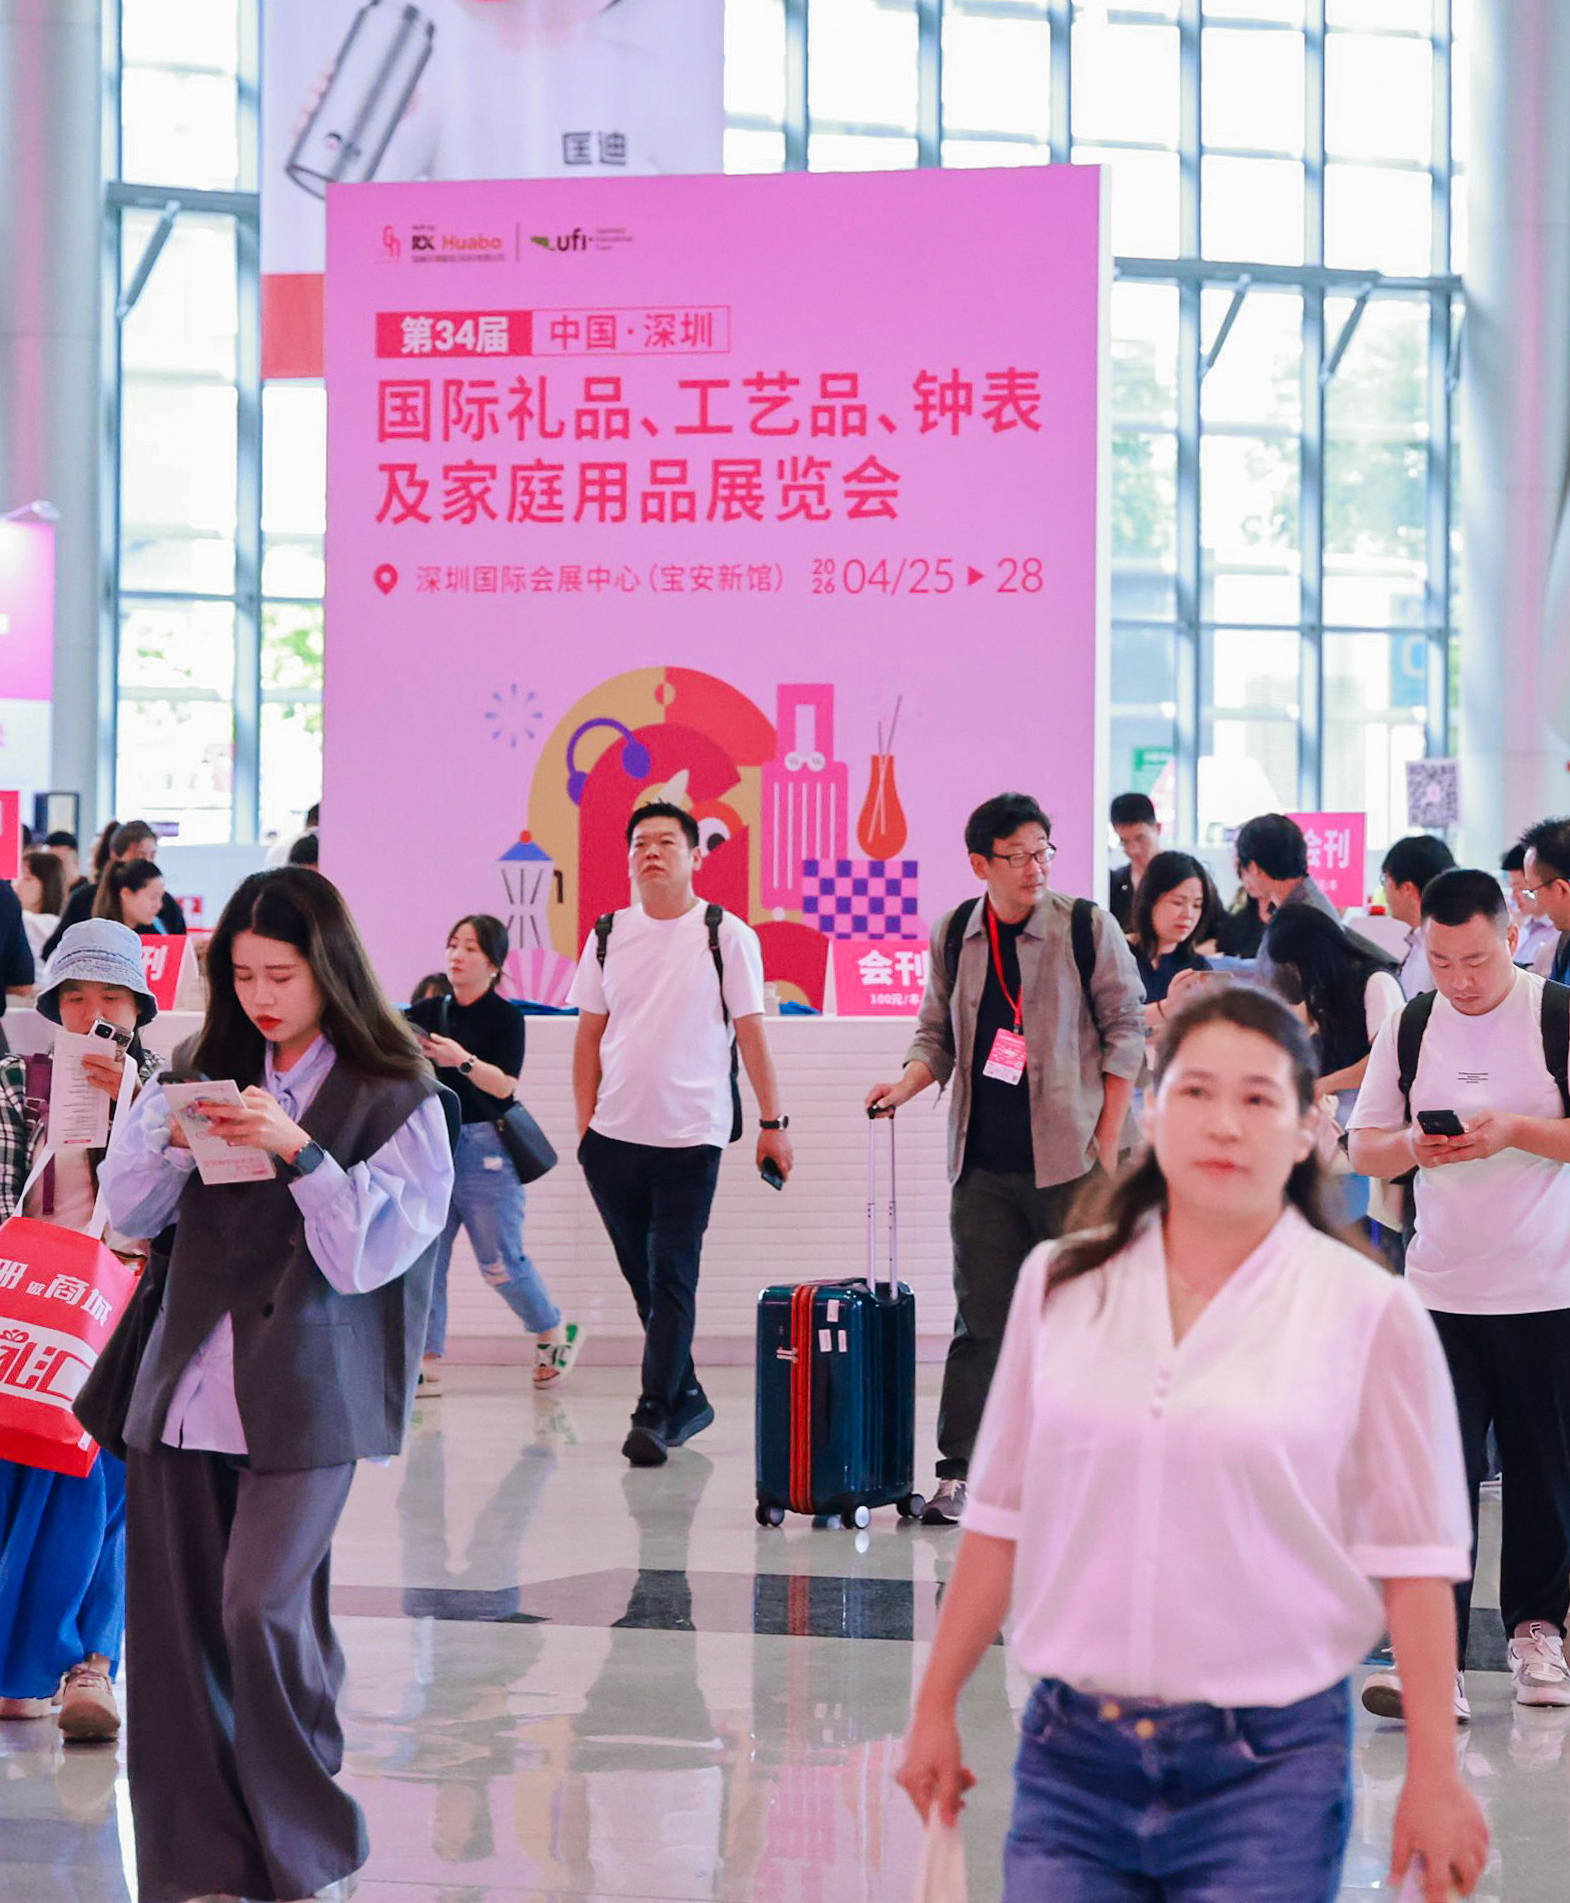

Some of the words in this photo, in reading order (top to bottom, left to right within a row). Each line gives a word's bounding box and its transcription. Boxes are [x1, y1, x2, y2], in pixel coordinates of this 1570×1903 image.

[563, 131, 626, 165] 匡迪
[442, 235, 502, 250] Huabo
[401, 316, 508, 353] 第34届
[377, 366, 1041, 442] 国际礼品、工艺品、钟表
[375, 455, 900, 525] 及家庭用品展览会
[842, 558, 953, 596] 04/25
[996, 557, 1043, 593] 28
[857, 949, 930, 987] 会刊
